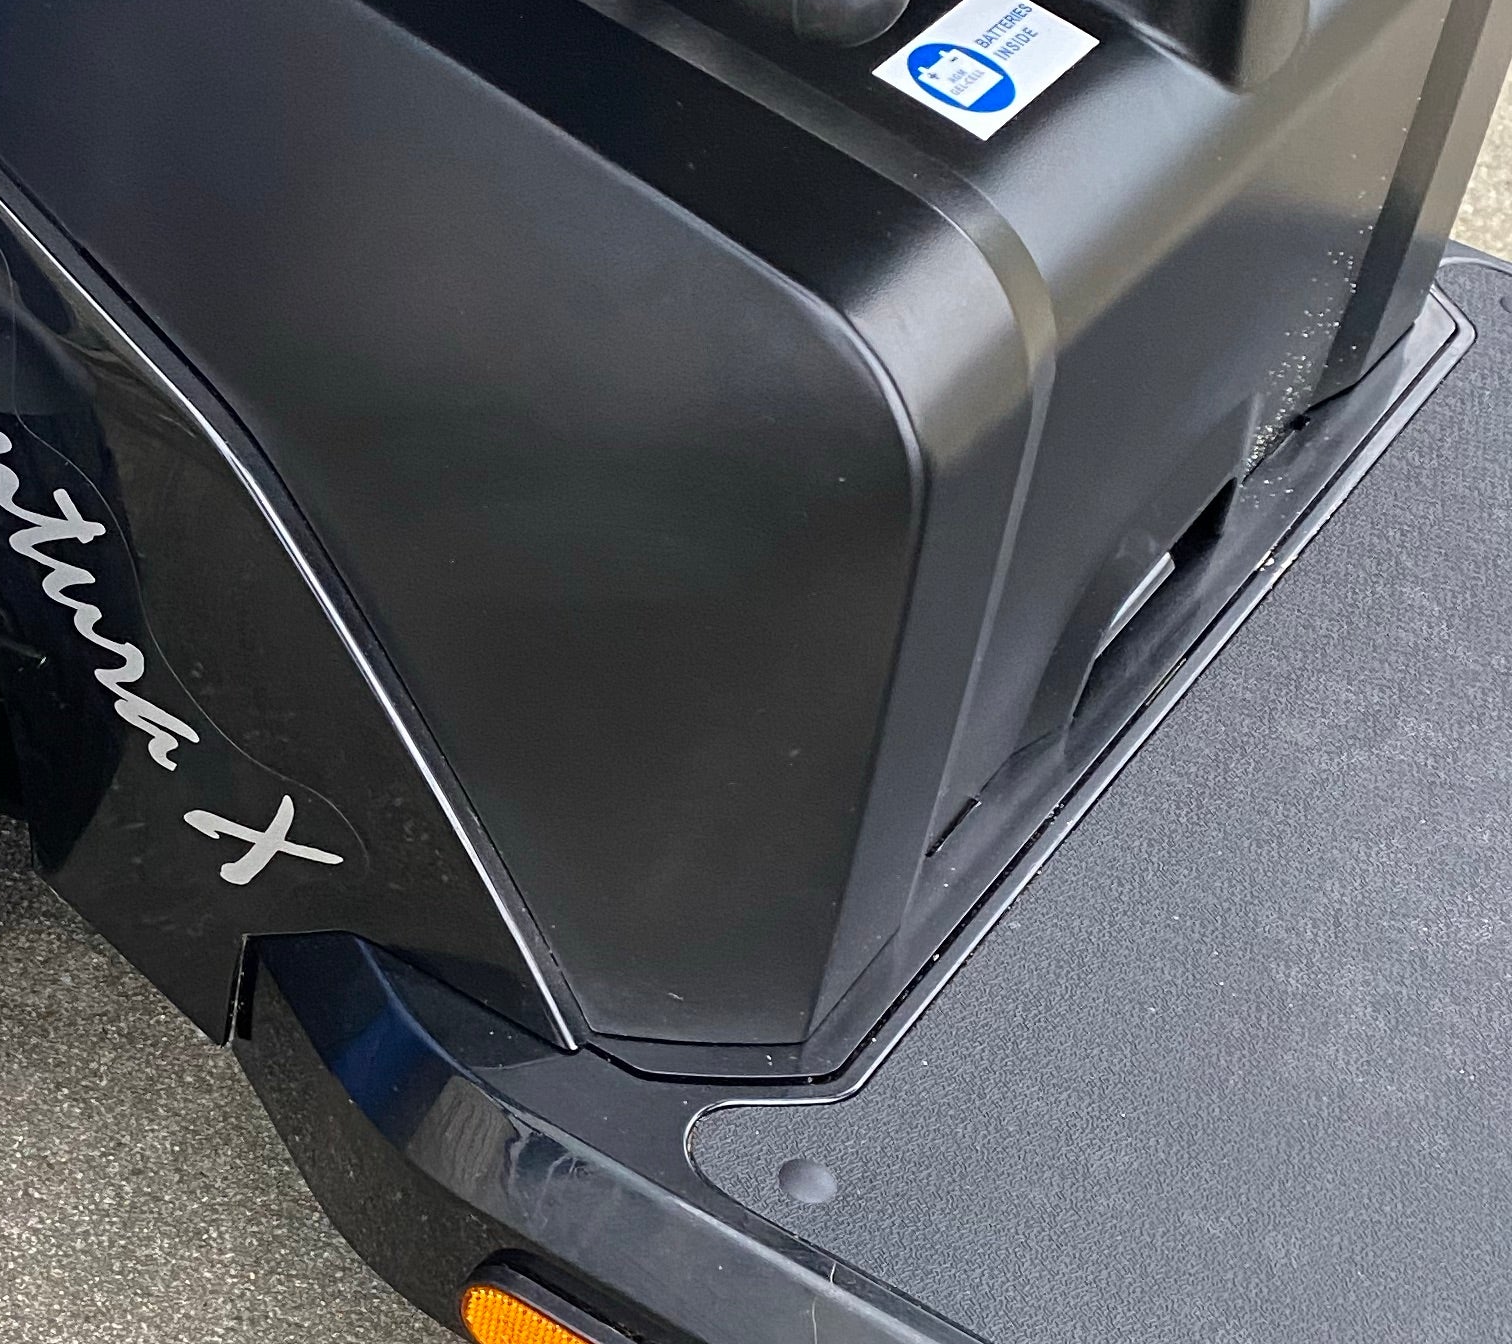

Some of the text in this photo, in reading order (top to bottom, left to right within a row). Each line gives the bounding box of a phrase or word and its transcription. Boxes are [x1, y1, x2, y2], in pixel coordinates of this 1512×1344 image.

[974, 2, 1033, 49] BATTERIES
[992, 26, 1039, 61] INSIDE
[183, 794, 344, 885] X
